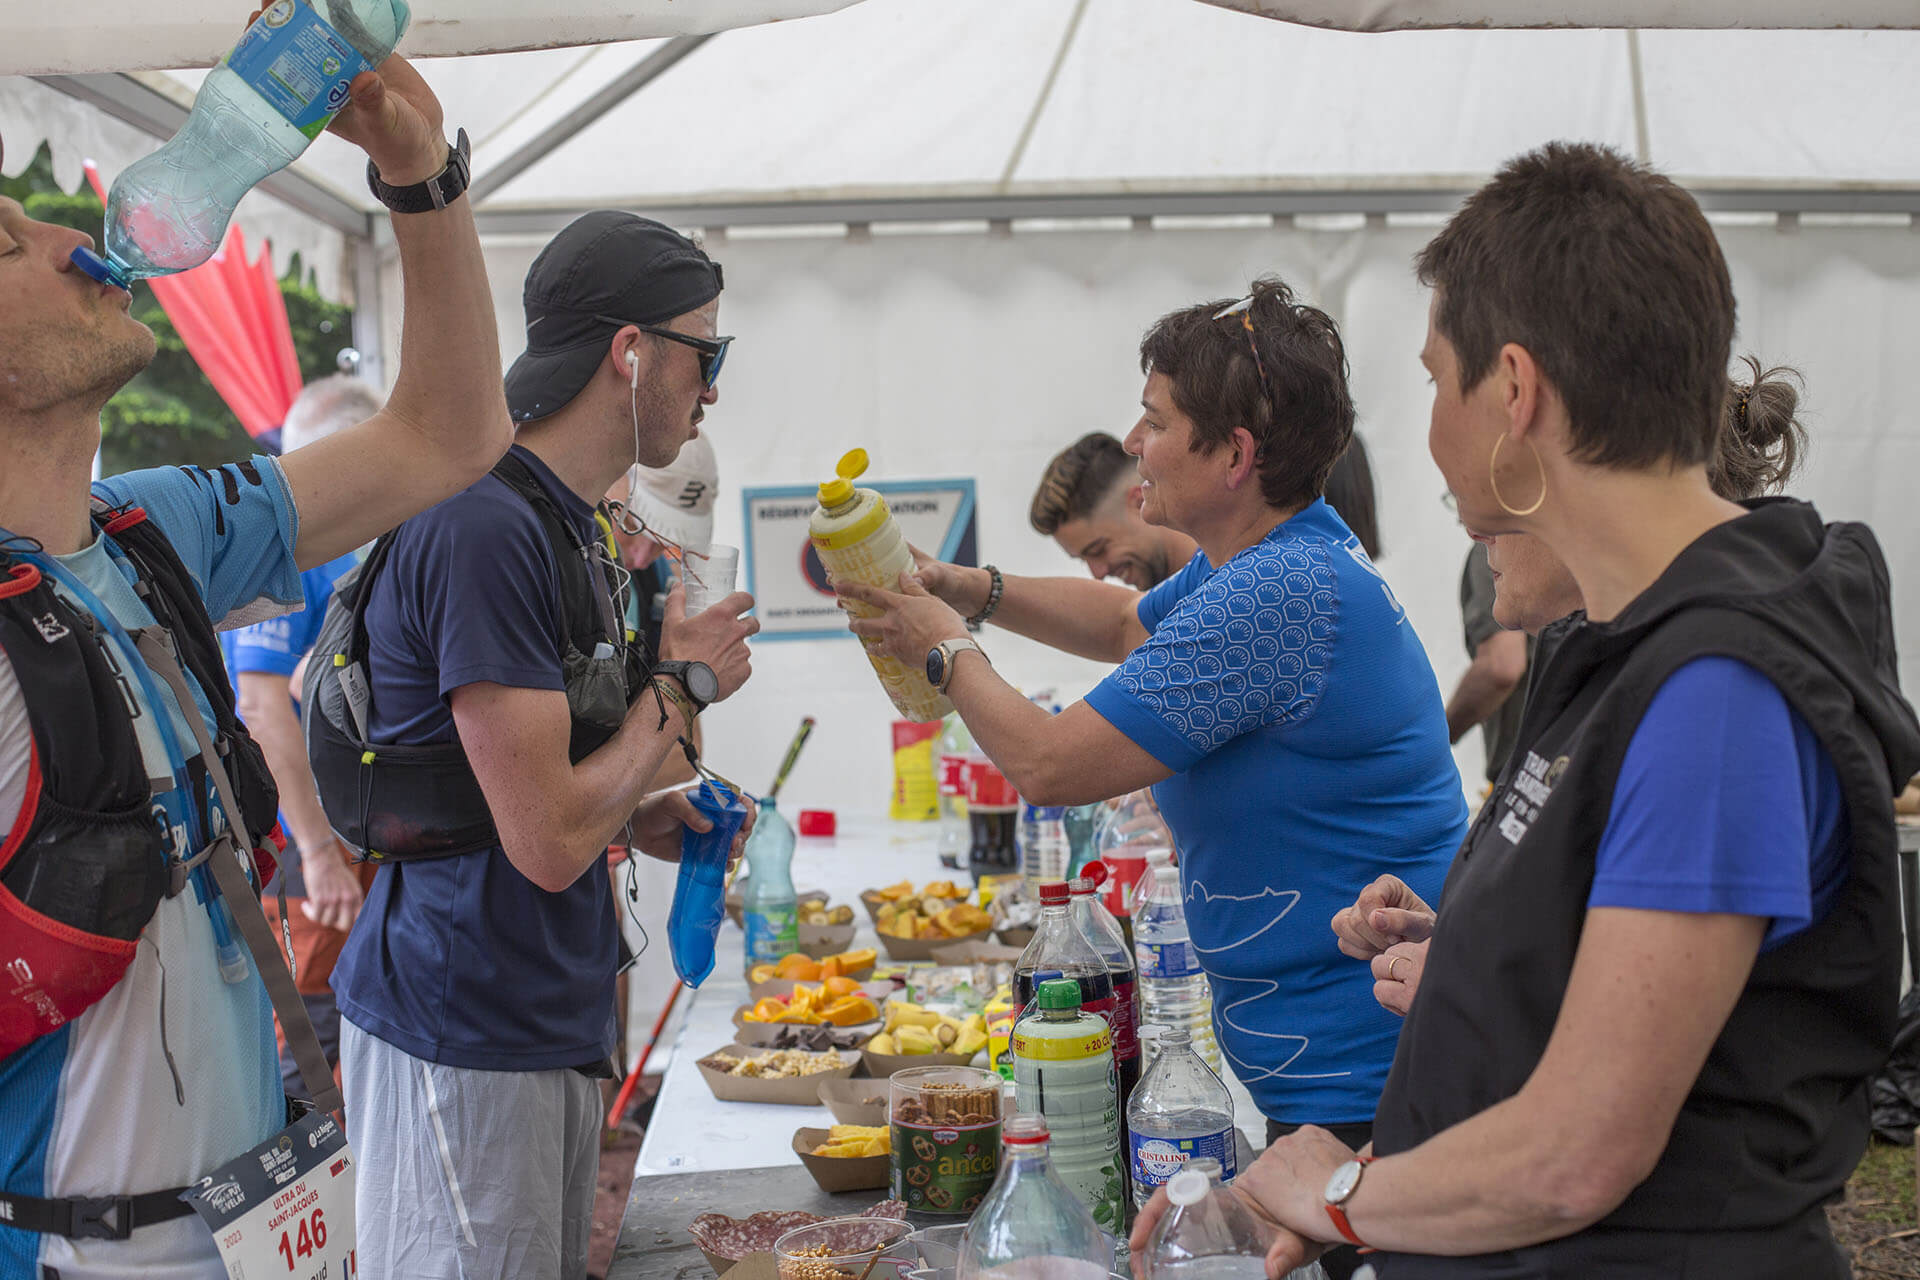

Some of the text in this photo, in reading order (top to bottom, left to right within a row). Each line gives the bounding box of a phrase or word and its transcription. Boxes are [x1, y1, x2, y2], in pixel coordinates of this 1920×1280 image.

[1091, 1038, 1102, 1051] 20
[938, 1146, 996, 1177] ancel
[1149, 1174, 1161, 1185] 30
[268, 1190, 320, 1232] SAINT-JACQUES
[273, 1182, 307, 1211] ULTRA DU
[223, 1229, 244, 1249] 2023
[278, 1208, 327, 1272] 146
